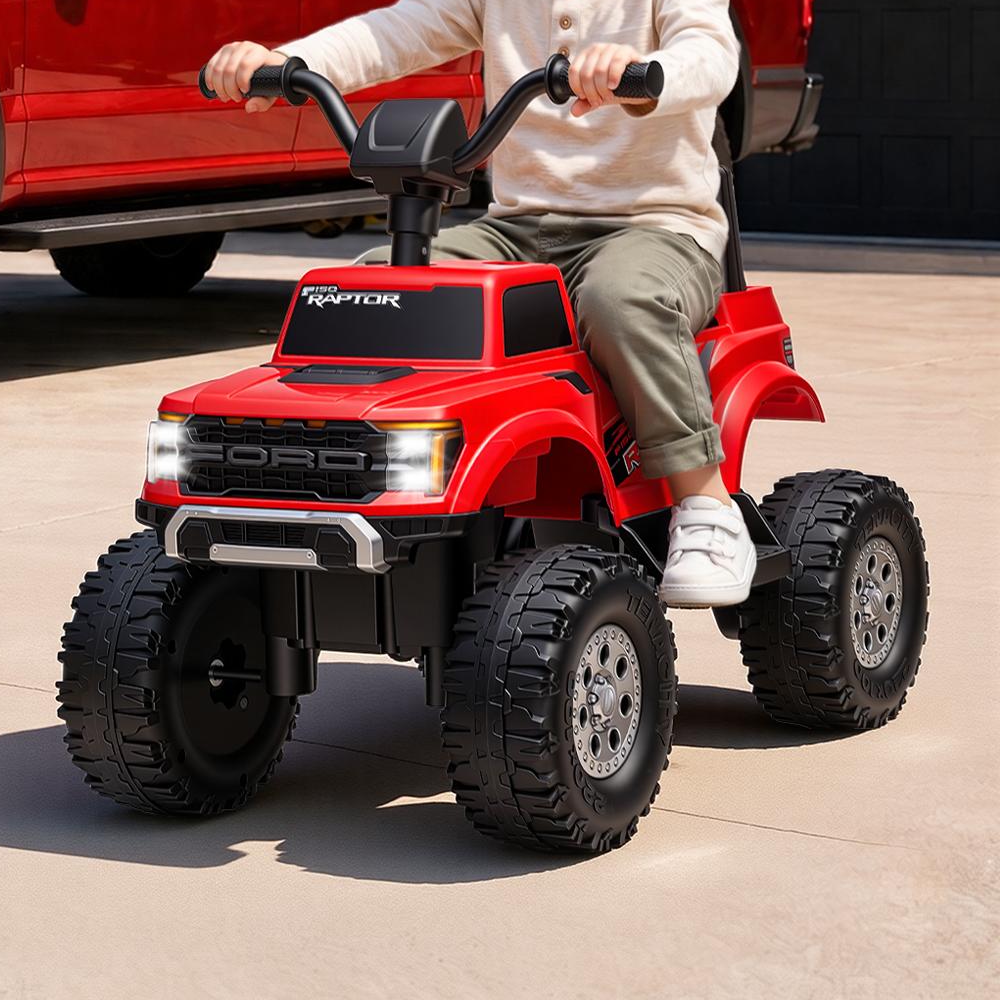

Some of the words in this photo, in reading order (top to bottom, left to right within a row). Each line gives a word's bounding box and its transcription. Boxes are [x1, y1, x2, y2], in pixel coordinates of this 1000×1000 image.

[307, 293, 402, 309] RAPTOR
[189, 444, 372, 471] FORD
[626, 587, 674, 747] TENACITY
